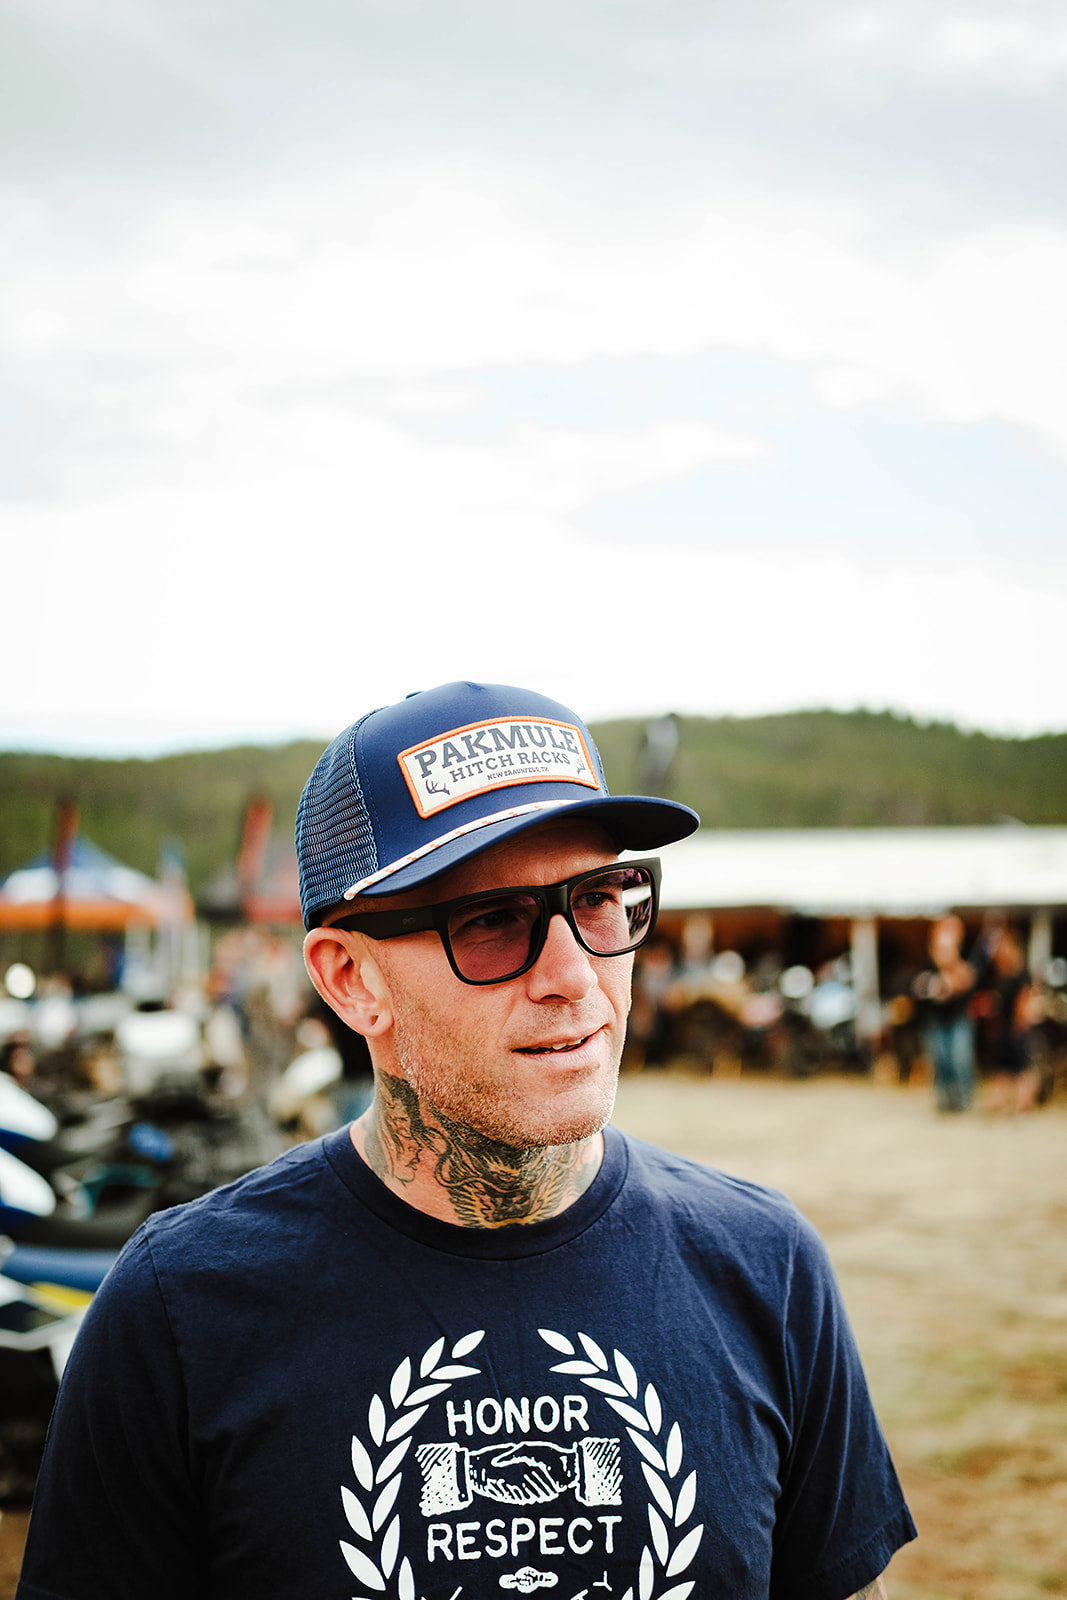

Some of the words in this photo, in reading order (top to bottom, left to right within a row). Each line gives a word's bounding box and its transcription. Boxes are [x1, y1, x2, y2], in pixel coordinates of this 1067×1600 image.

[414, 725, 579, 778] PAKMULE
[449, 754, 514, 782] HITCH
[517, 751, 570, 765] RACKS
[487, 772, 503, 780] NEW
[446, 1394, 589, 1436] HONOR
[427, 1515, 623, 1562] RESPECT
